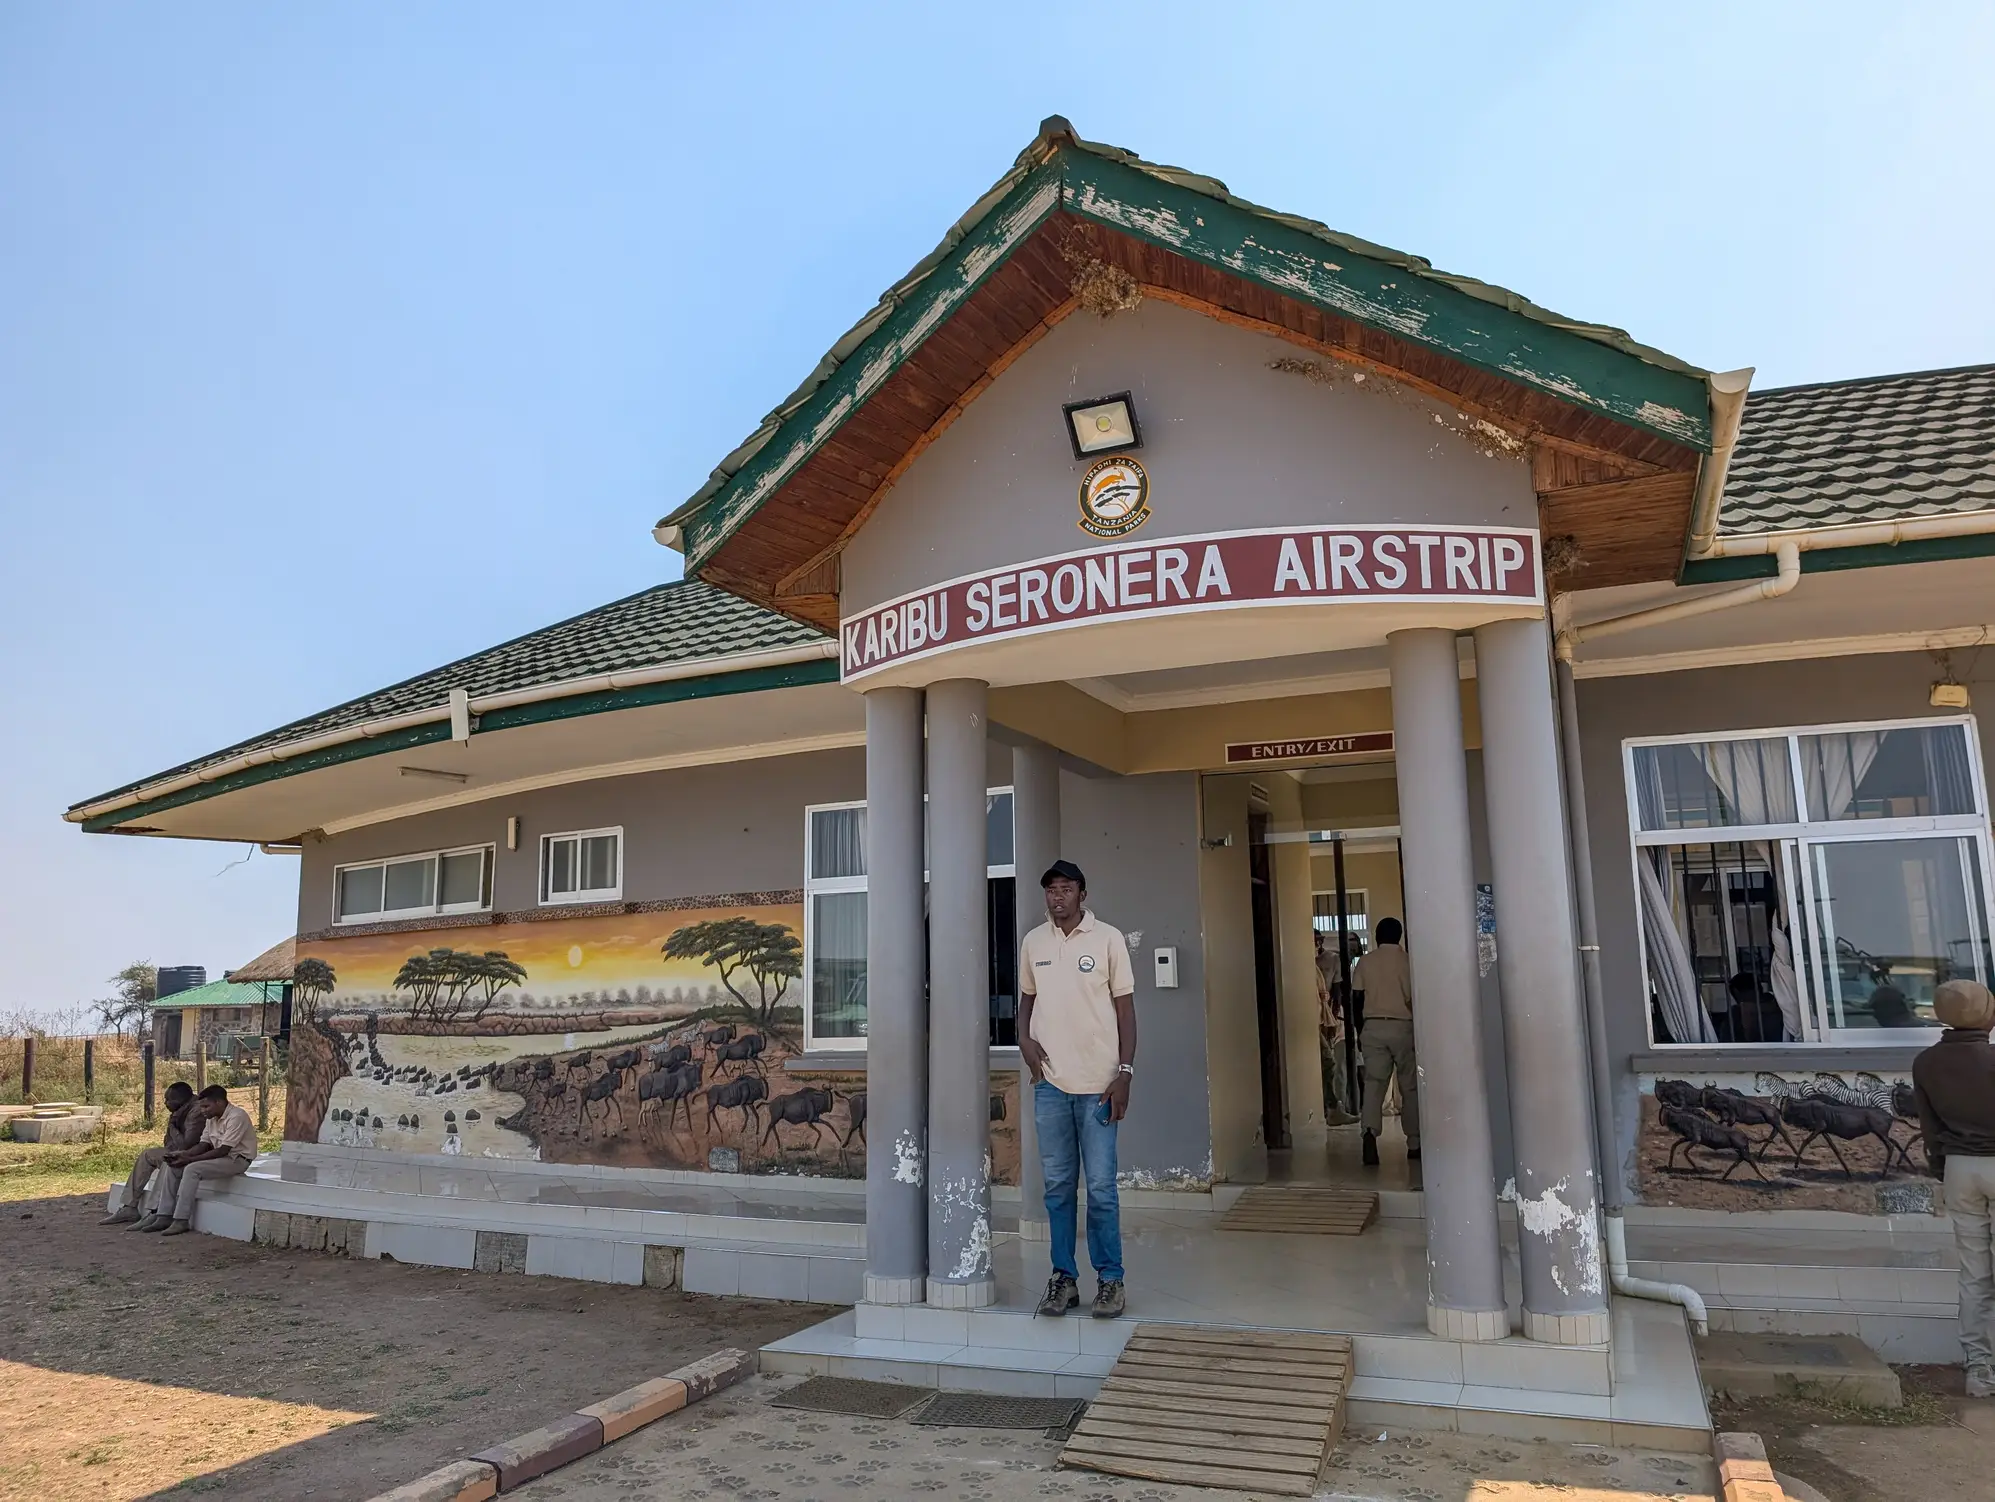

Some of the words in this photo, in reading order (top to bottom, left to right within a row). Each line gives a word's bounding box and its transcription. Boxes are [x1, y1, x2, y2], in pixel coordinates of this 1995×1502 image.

[1115, 458, 1126, 466] ZA
[1127, 460, 1144, 479] TAIFA
[1084, 522, 1122, 536] NATIONAL
[1125, 512, 1146, 531] PARKS
[1091, 510, 1137, 526] TANZANIA
[846, 592, 948, 670] KARIBU
[966, 544, 1232, 632] SERONERA
[1273, 534, 1525, 591] AIRSTRIP
[1251, 738, 1356, 758] ENTRY/EXIT
